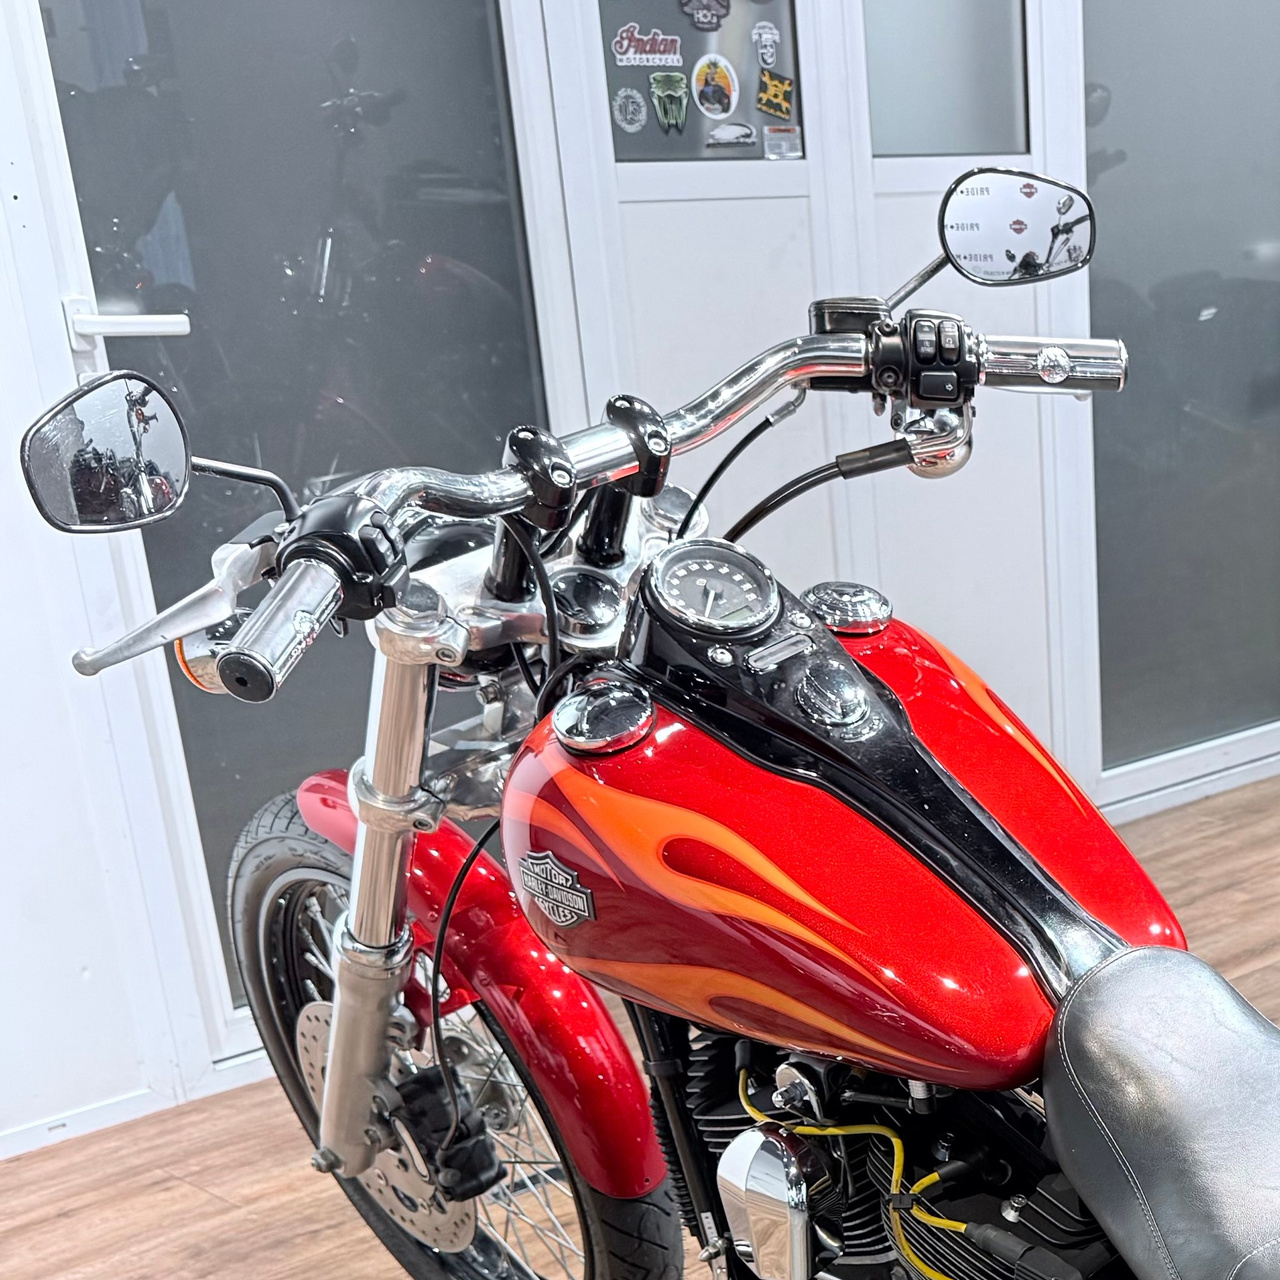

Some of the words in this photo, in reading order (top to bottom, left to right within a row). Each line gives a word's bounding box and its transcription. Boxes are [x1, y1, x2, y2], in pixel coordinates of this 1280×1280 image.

[693, 9, 718, 23] HOG
[615, 25, 678, 55] Indian
[533, 863, 568, 887] MOTOR
[523, 873, 585, 911] HARLEY-DAVIDSON
[539, 897, 572, 922] CYCLES
